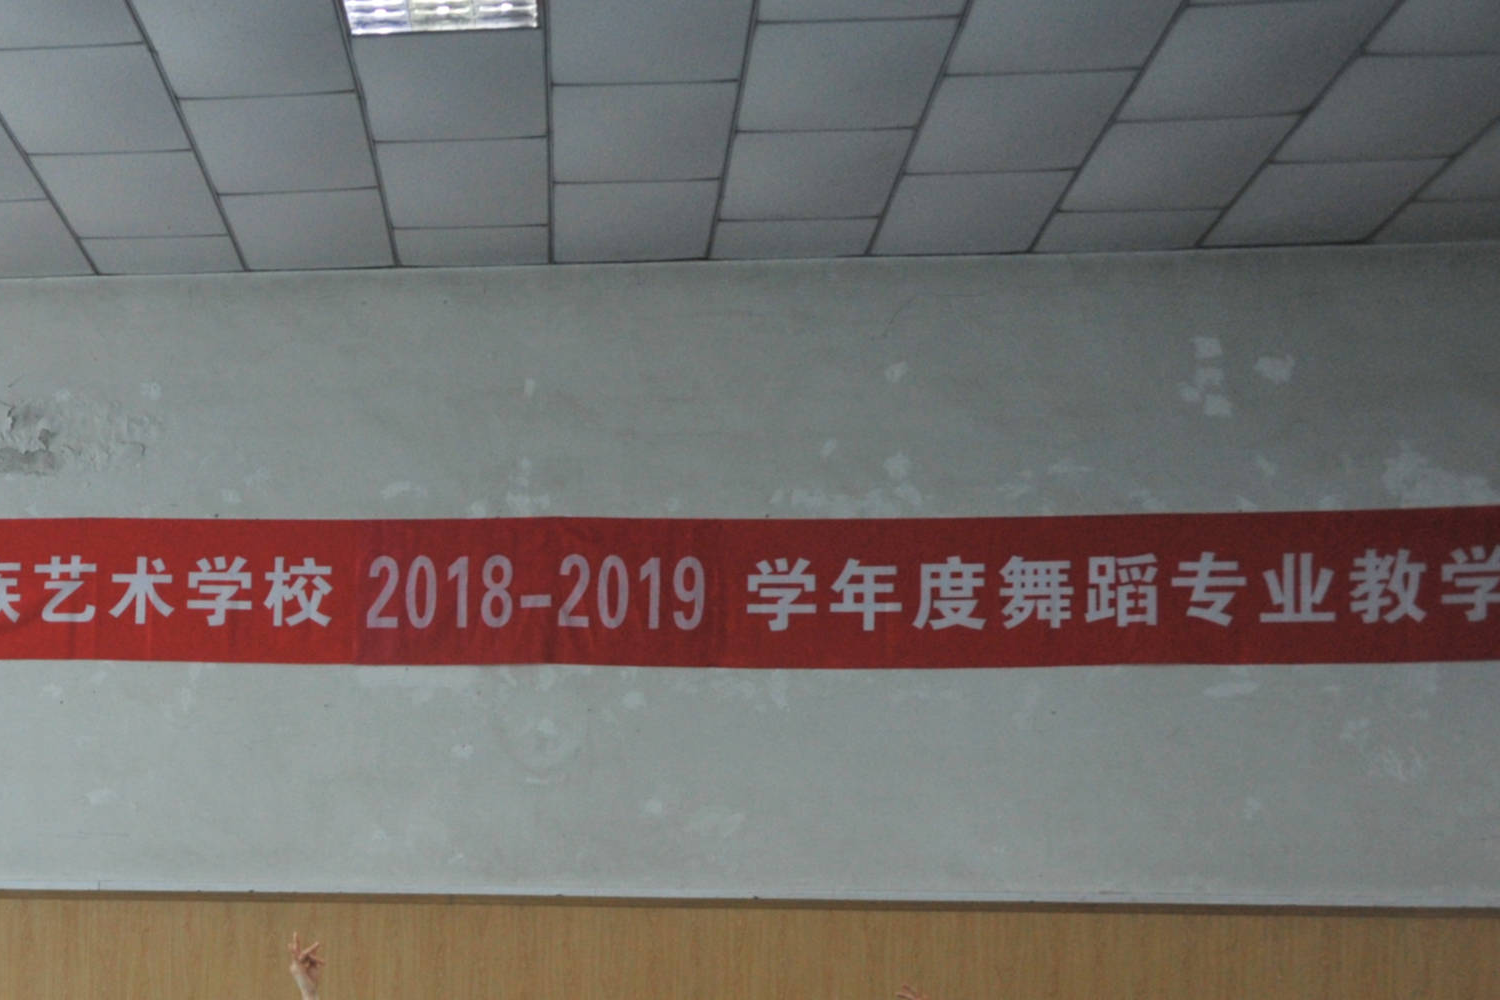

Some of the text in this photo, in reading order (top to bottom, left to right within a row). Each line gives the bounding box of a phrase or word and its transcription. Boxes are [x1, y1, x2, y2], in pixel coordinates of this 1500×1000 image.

[367, 554, 705, 631] 2018-2019
[746, 546, 1500, 632] 学年度舞蹈专业教学
